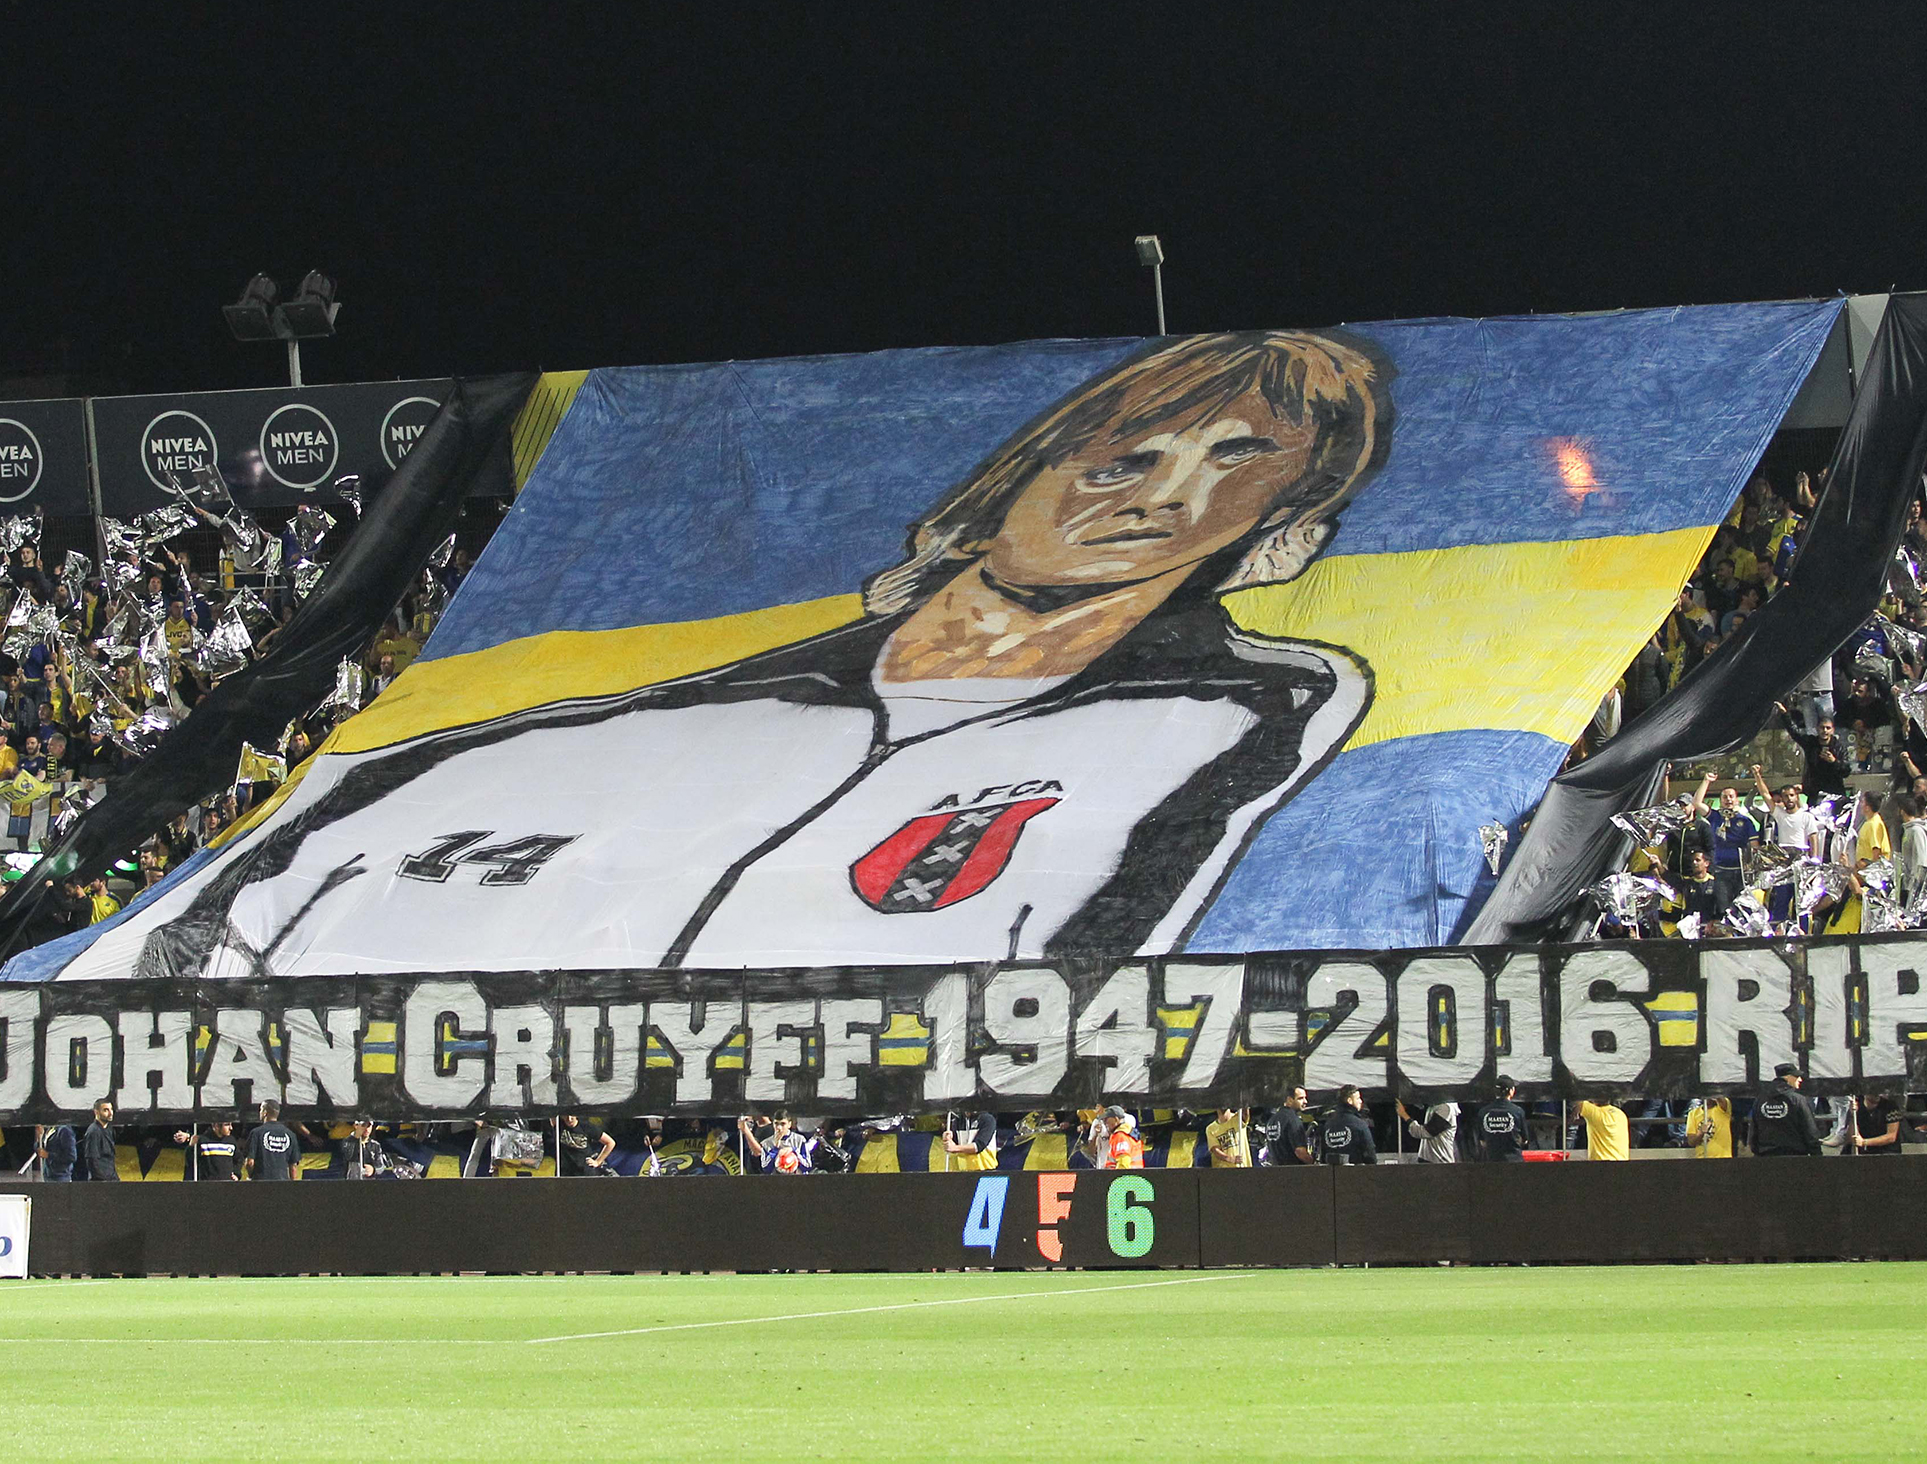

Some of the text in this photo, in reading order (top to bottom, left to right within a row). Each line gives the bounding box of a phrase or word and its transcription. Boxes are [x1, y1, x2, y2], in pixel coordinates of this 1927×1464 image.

[270, 430, 329, 448] NIVEA
[391, 425, 426, 441] NIV
[0, 445, 33, 460] VEA
[151, 437, 208, 454] NIVEA
[158, 454, 203, 471] MEN
[277, 448, 324, 465] MEN
[0, 463, 28, 478] EN
[397, 829, 585, 887] 14
[0, 989, 361, 1110] JOHAN
[404, 981, 884, 1108] CRUYFF
[1699, 941, 1927, 1084] RIP
[962, 1176, 1010, 1259] 4
[1106, 1174, 1155, 1259] 6
